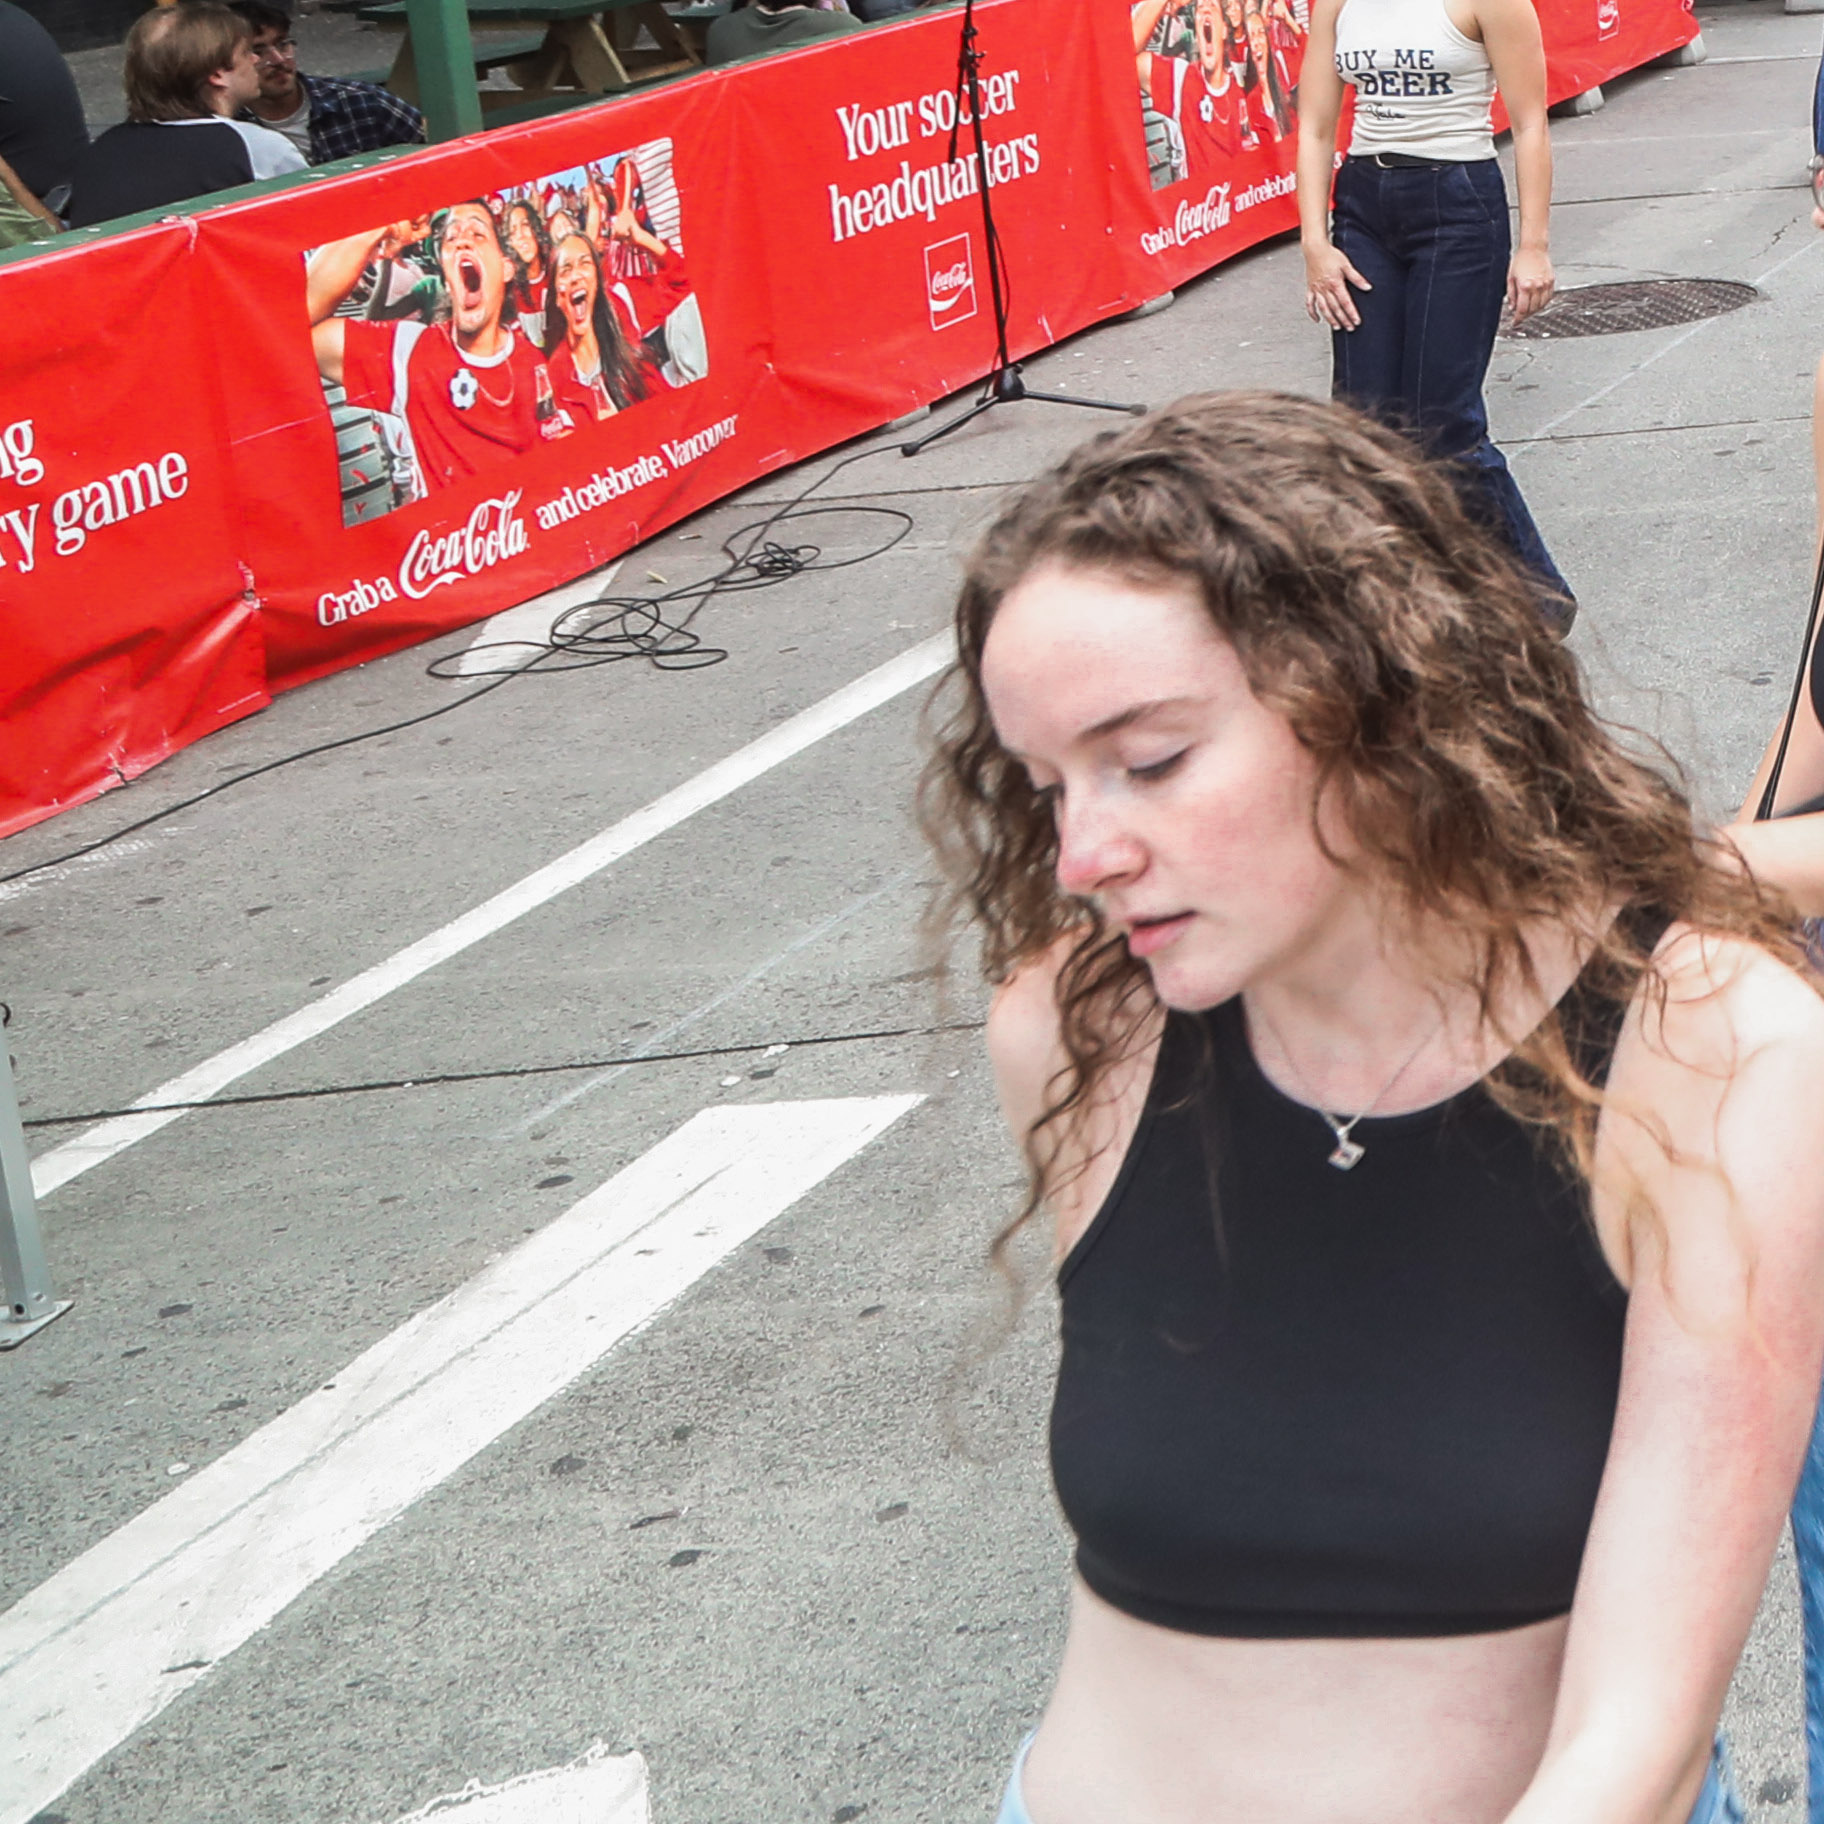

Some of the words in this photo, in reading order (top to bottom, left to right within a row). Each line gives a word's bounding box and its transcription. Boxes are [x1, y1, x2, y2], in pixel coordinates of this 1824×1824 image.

[1335, 48, 1378, 74] BUY
[1394, 48, 1435, 70] ME
[1353, 70, 1454, 97] BEER
[836, 102, 914, 162] Your
[918, 69, 1020, 138] soccer
[828, 133, 1041, 243] headquarters
[1140, 226, 1169, 256] Grab
[1175, 180, 1232, 247] Coca-Cola
[1234, 183, 1255, 213] and
[52, 451, 189, 556] game
[317, 580, 379, 627] Grab
[380, 576, 398, 601] a
[398, 487, 531, 600] Coca-Cola
[537, 488, 580, 530] and
[579, 453, 669, 511] celebrate,
[661, 414, 740, 470] Vancouver
